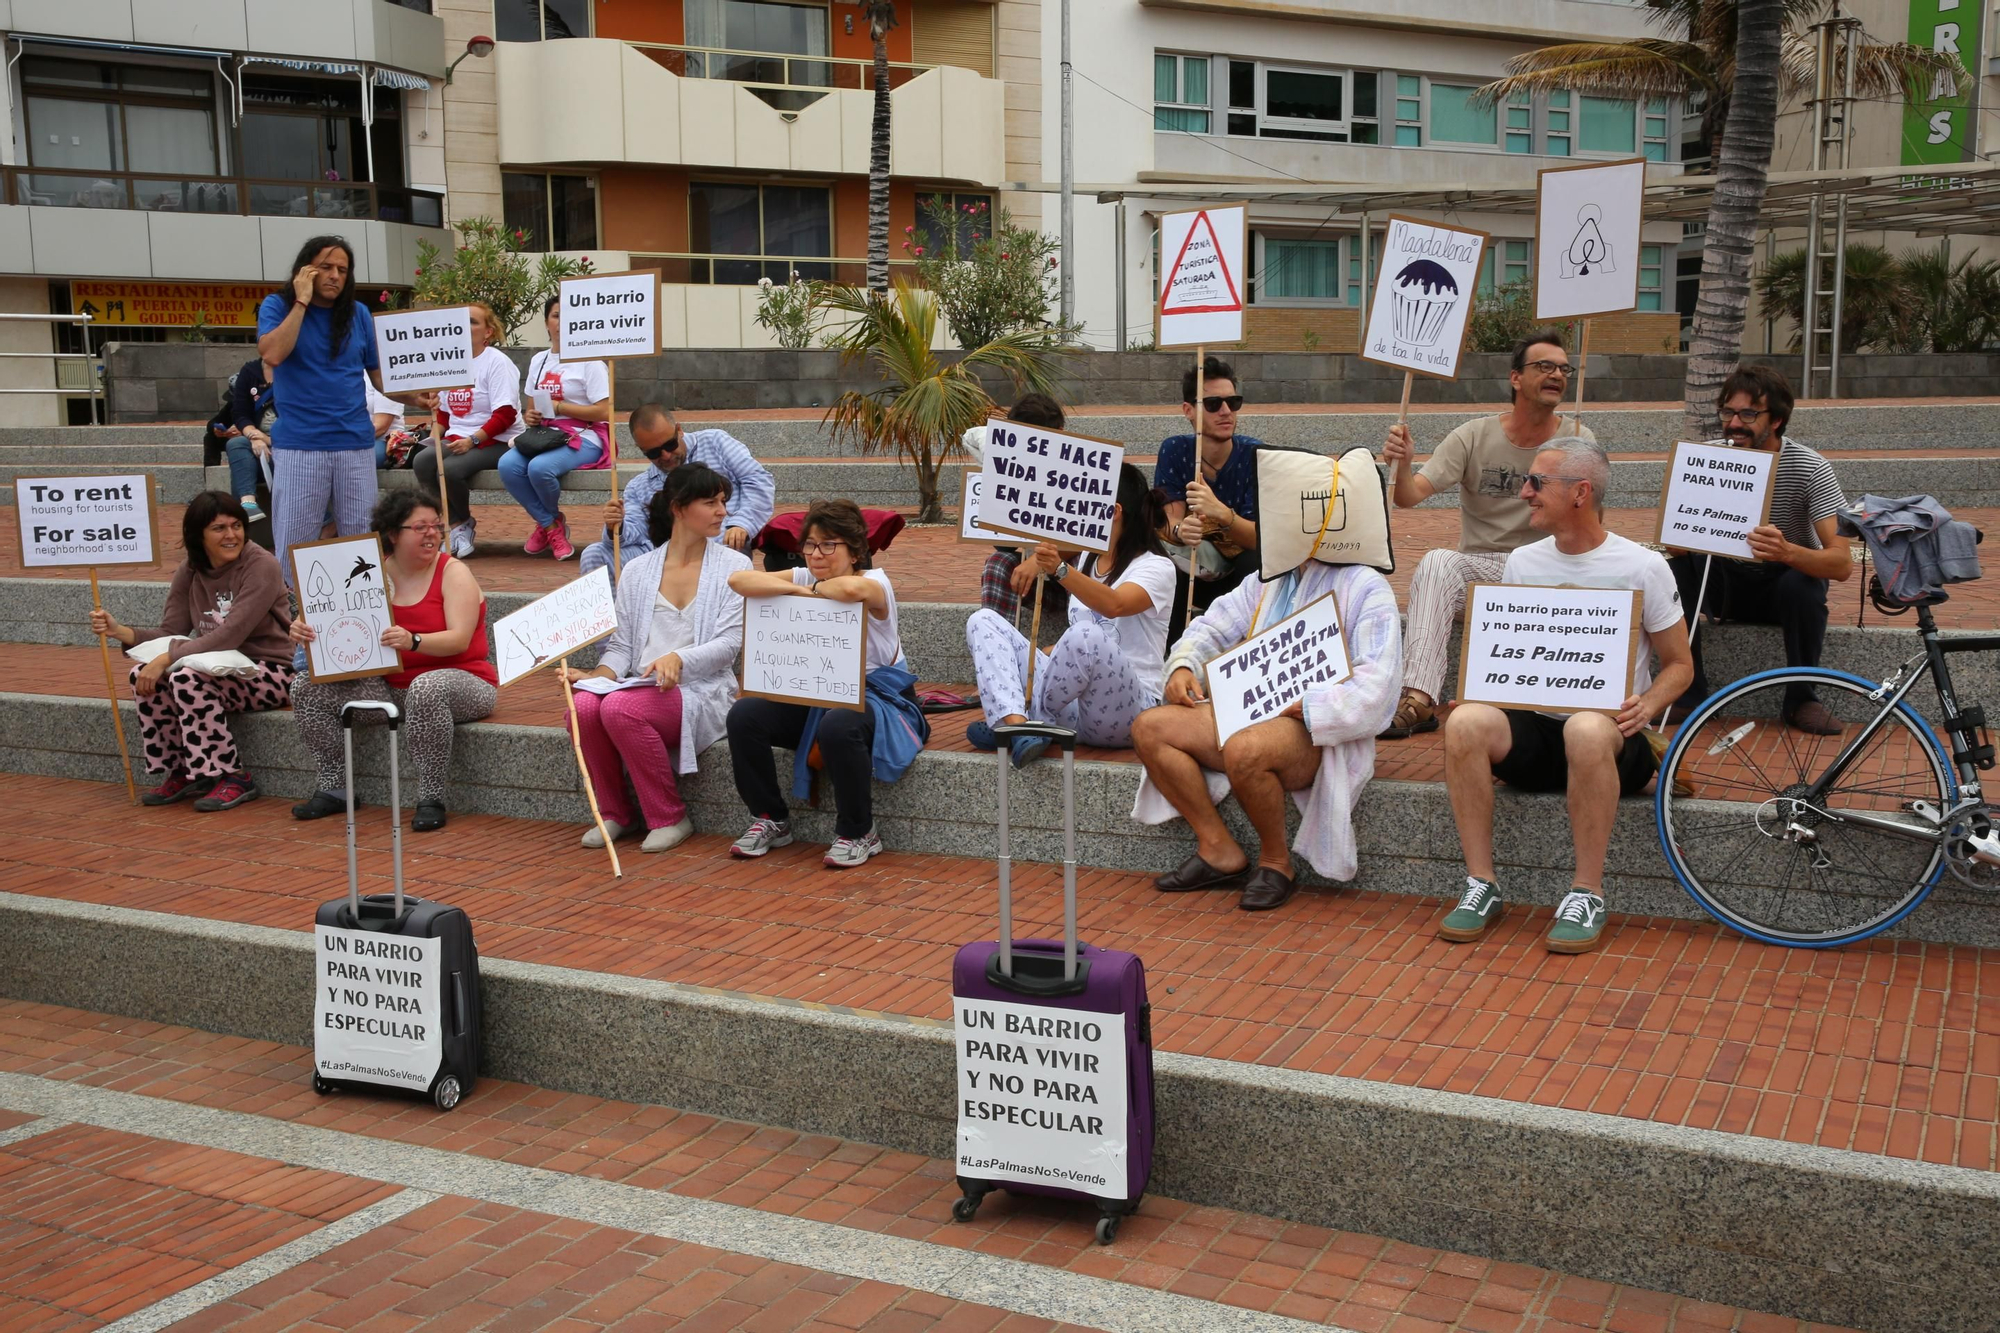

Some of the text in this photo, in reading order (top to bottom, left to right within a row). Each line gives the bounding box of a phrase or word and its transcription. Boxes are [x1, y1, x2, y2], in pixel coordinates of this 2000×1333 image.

[1188, 239, 1211, 250] ZONA
[1393, 223, 1474, 265] Magdalena
[1173, 271, 1215, 286] SATURADA
[76, 284, 224, 298] RESTAURANTE
[570, 290, 644, 307] Un barrio
[133, 301, 243, 312] PUERTA DE ORO
[139, 313, 238, 324] GOLDEN GATE
[569, 314, 645, 334] para vivir
[386, 323, 463, 341] Un barrio
[568, 337, 646, 346] #LasPalmasNoSeVende
[389, 347, 465, 368] para vivir
[1374, 338, 1449, 367] de toa la vida
[449, 392, 470, 401] STOP
[992, 429, 1111, 472] NO SE HACE
[1687, 457, 1756, 475] UN BARRIO
[1683, 473, 1754, 492] PARA VIVIR
[30, 484, 132, 502] To rent
[996, 484, 1020, 504] EN
[1028, 492, 1047, 508] EL
[1055, 497, 1115, 520] CENTRO
[32, 503, 133, 515] housing for tourists
[1678, 504, 1748, 523] Las Palmas
[34, 524, 136, 542] For sale
[1673, 522, 1747, 540] no se vende
[35, 542, 137, 556] neighborhood's soul
[534, 574, 600, 616] PA LIMPIAR
[306, 598, 336, 614] airbnb
[547, 613, 560, 628] PA
[566, 587, 609, 618] SERVIR
[760, 605, 858, 624] EN LA ISLETA
[1486, 602, 1618, 617] Un barrio para vivir
[330, 628, 337, 638] SE
[352, 620, 370, 639] JUNTOS
[547, 630, 563, 647] SIN
[565, 618, 587, 638] SITIO
[567, 616, 616, 648] PA DORMIR
[1482, 622, 1489, 631] y
[1514, 624, 1544, 633] para
[1548, 625, 1618, 635] especular
[757, 631, 852, 649] O GUANARTEME
[332, 647, 368, 664] CENAR
[1490, 644, 1604, 663] Las Palmas
[820, 656, 834, 674] YA
[1258, 659, 1271, 677] Y
[763, 670, 858, 696] NO SE PUEDE
[1485, 672, 1605, 690] no se vende
[325, 935, 423, 962] UN BARRIO
[328, 961, 422, 988] PARA VIVIR
[328, 987, 422, 1014] Y NO PARA
[325, 1012, 425, 1041] ESPECULAR
[963, 1009, 1101, 1042] UN BARRIO
[966, 1040, 1099, 1073] PARA VIVIR
[321, 1060, 427, 1083] #LasPalmasNoSeVende
[966, 1070, 1098, 1104] Y NO PARA
[964, 1100, 1103, 1135] ESPECULAR
[960, 1155, 1106, 1186] #LasPalmasNoSeVende
